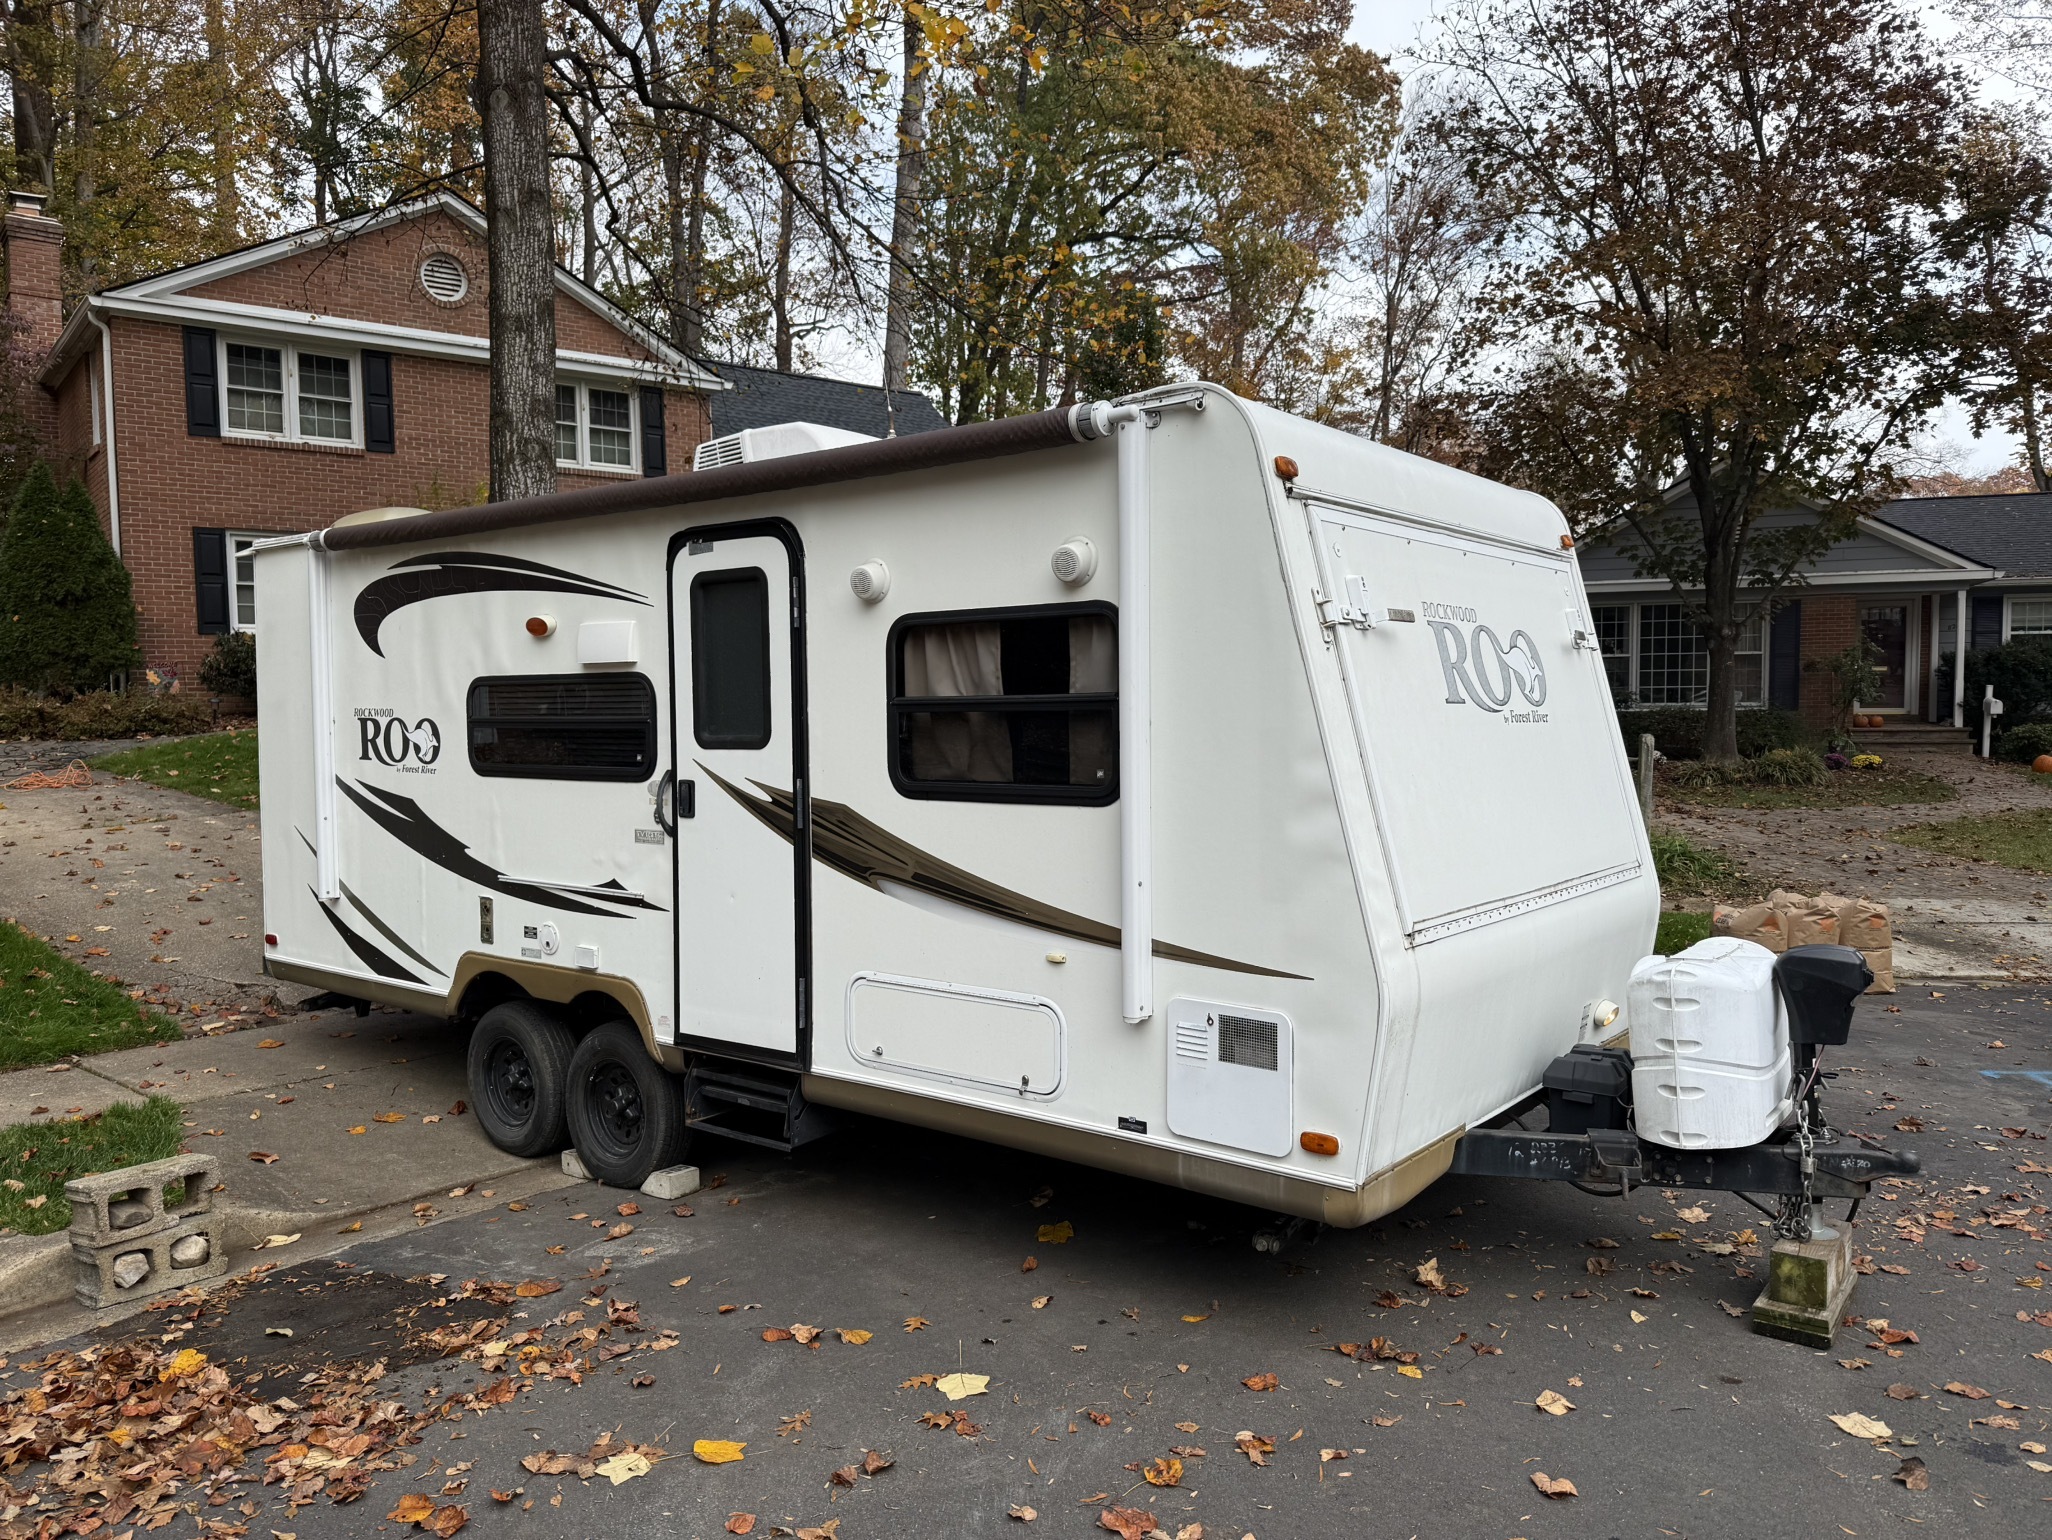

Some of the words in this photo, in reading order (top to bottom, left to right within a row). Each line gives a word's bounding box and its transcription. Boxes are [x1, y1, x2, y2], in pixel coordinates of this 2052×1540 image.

[1421, 601, 1478, 623] ROCKWOOD
[1427, 620, 1547, 713] ROO
[354, 707, 394, 718] ROCKWOOD
[1509, 709, 1531, 723] Forest
[1531, 709, 1549, 723] River
[357, 717, 441, 767] ROO
[401, 764, 420, 774] Forest
[420, 765, 437, 775] River
